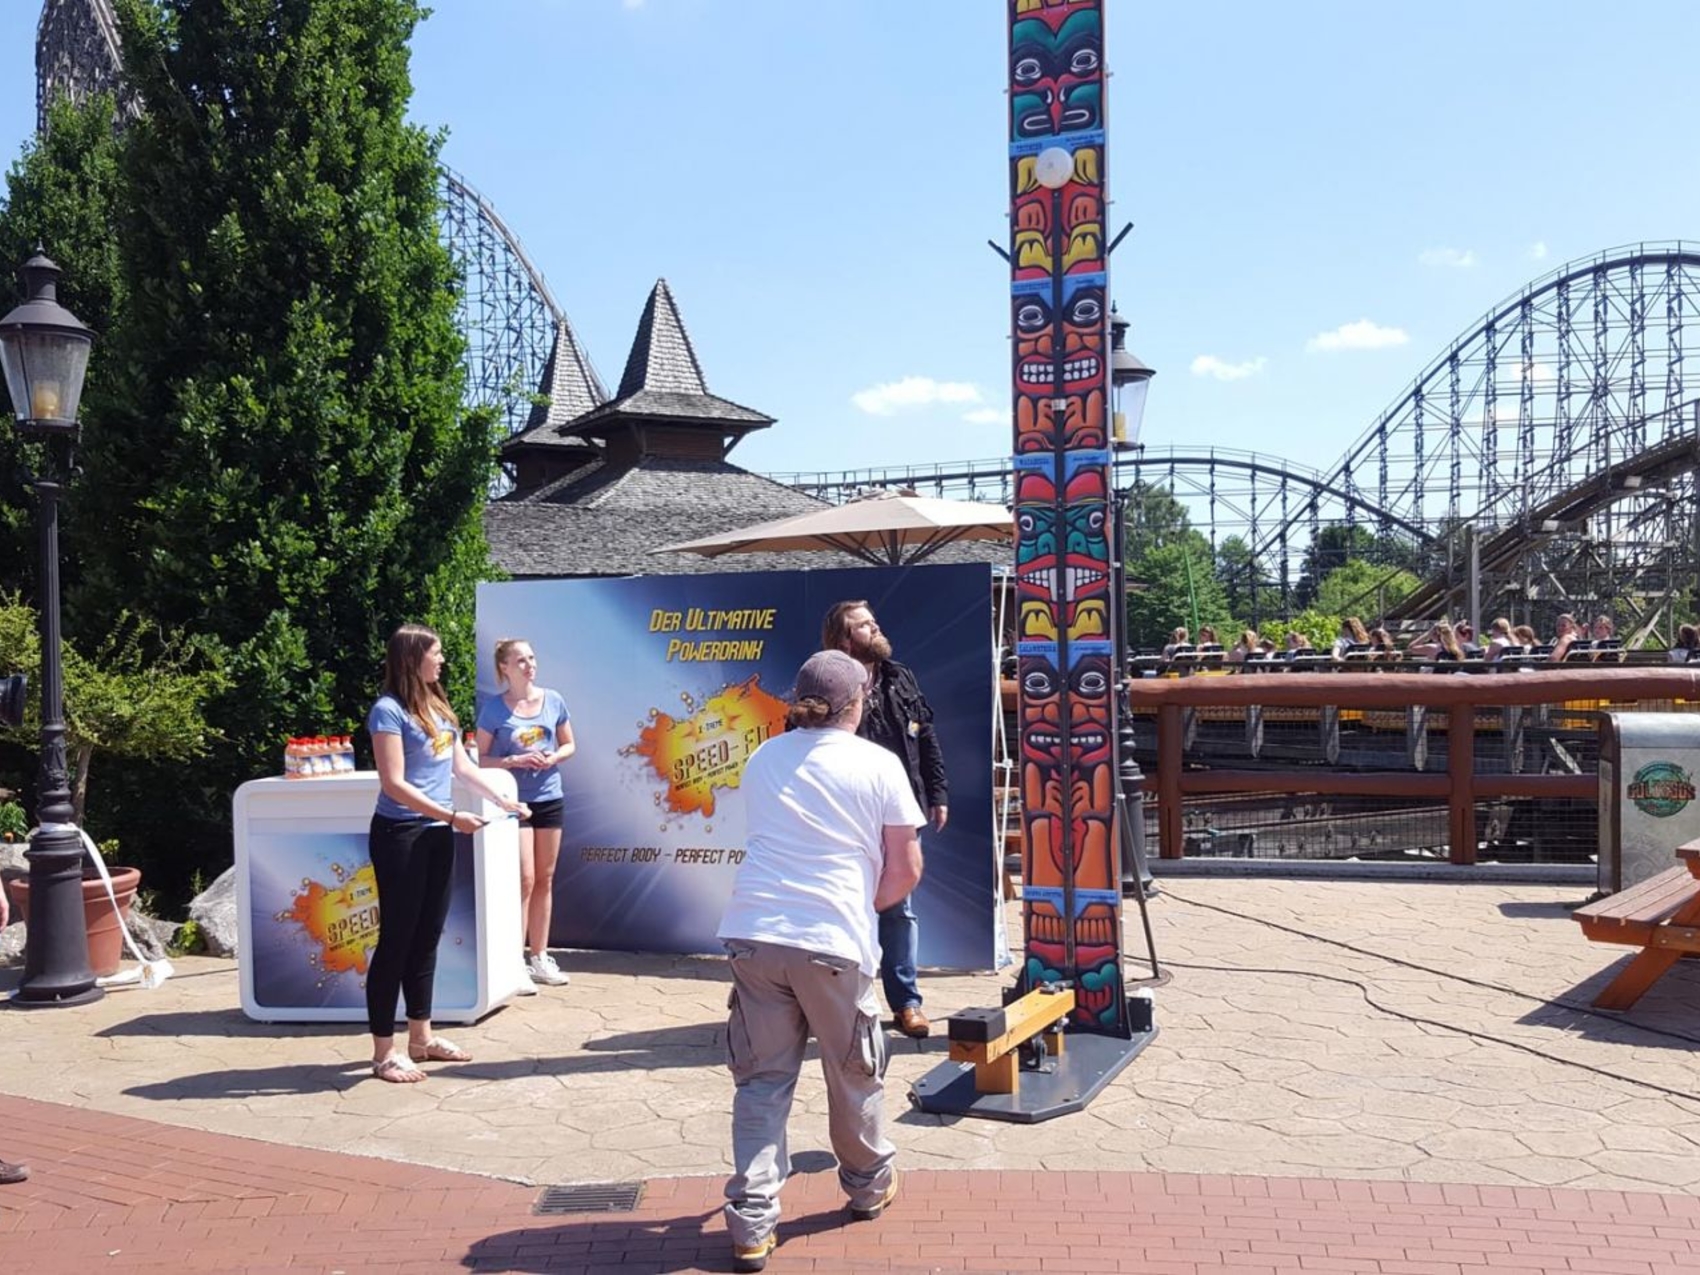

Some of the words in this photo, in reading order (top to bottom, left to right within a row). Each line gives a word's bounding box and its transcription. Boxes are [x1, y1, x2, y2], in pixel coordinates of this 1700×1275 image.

[650, 609, 681, 632] DER
[685, 608, 777, 631] ULTIMATIVE
[666, 639, 764, 662] POWERDRINK
[580, 847, 631, 864] PERFECT
[631, 847, 661, 864] BODY
[674, 848, 725, 865] PERFECT
[727, 849, 747, 865] PO
